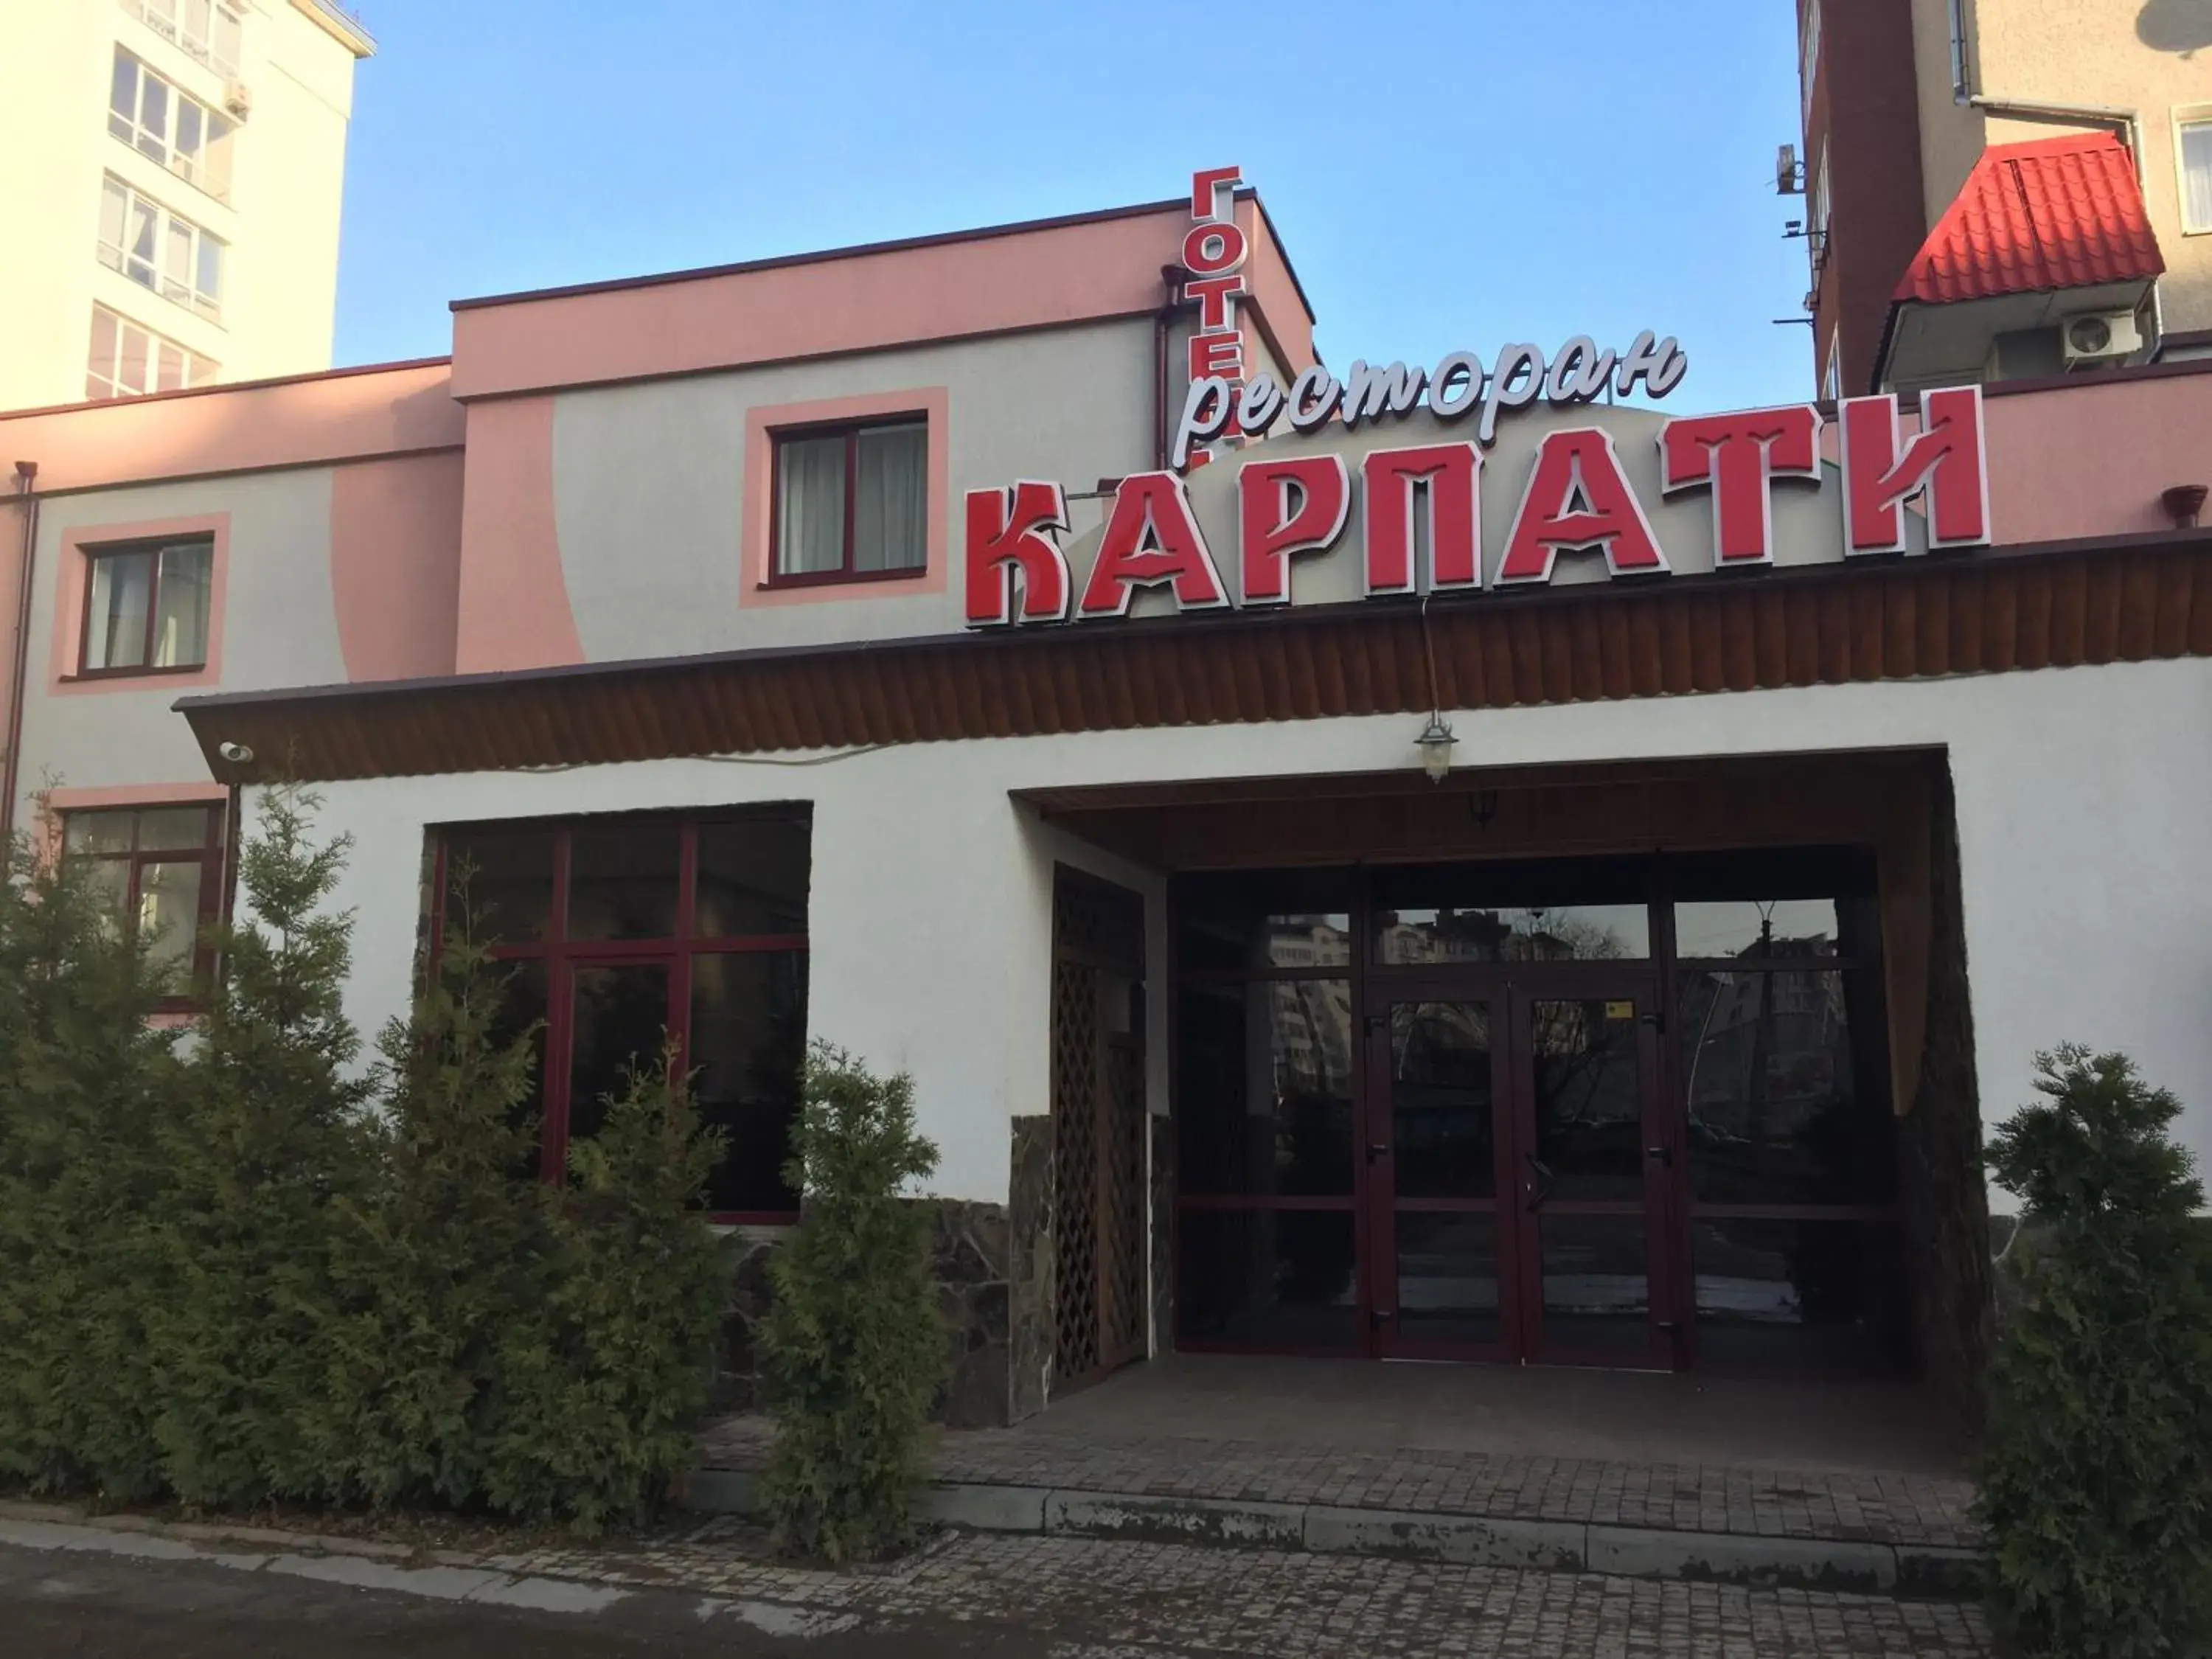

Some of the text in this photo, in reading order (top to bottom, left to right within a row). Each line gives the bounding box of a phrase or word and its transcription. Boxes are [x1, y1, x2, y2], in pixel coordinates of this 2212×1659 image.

[1172, 328, 1688, 470] ресторан
[1183, 165, 1248, 472] ГОТЕ
[964, 384, 1992, 628] КАРПАТИ
